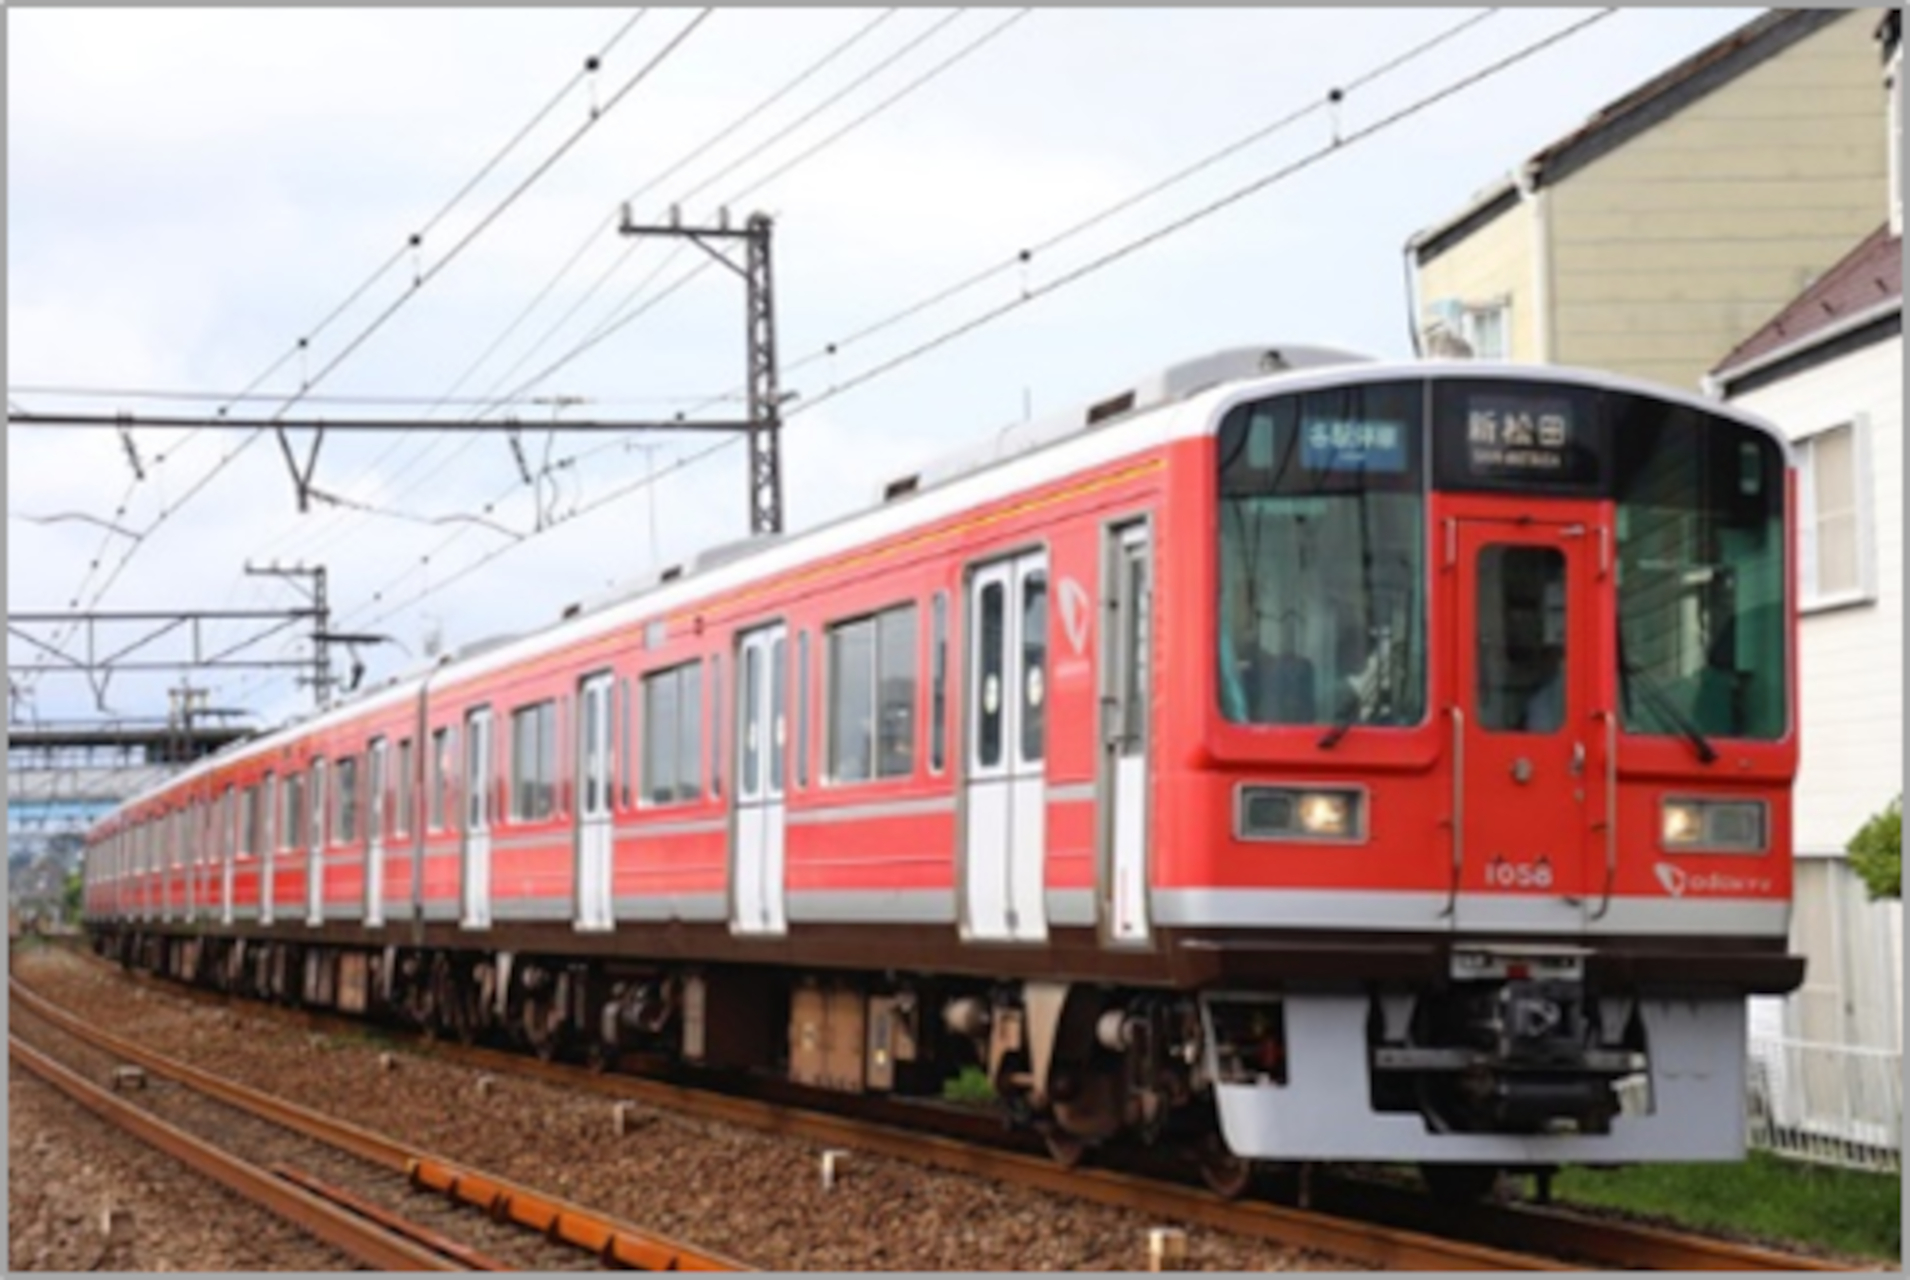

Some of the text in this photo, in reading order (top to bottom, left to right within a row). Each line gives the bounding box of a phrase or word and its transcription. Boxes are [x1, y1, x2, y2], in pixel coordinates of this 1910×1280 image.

[1468, 411, 1565, 446] 新松田
[1485, 862, 1553, 888] 1058
